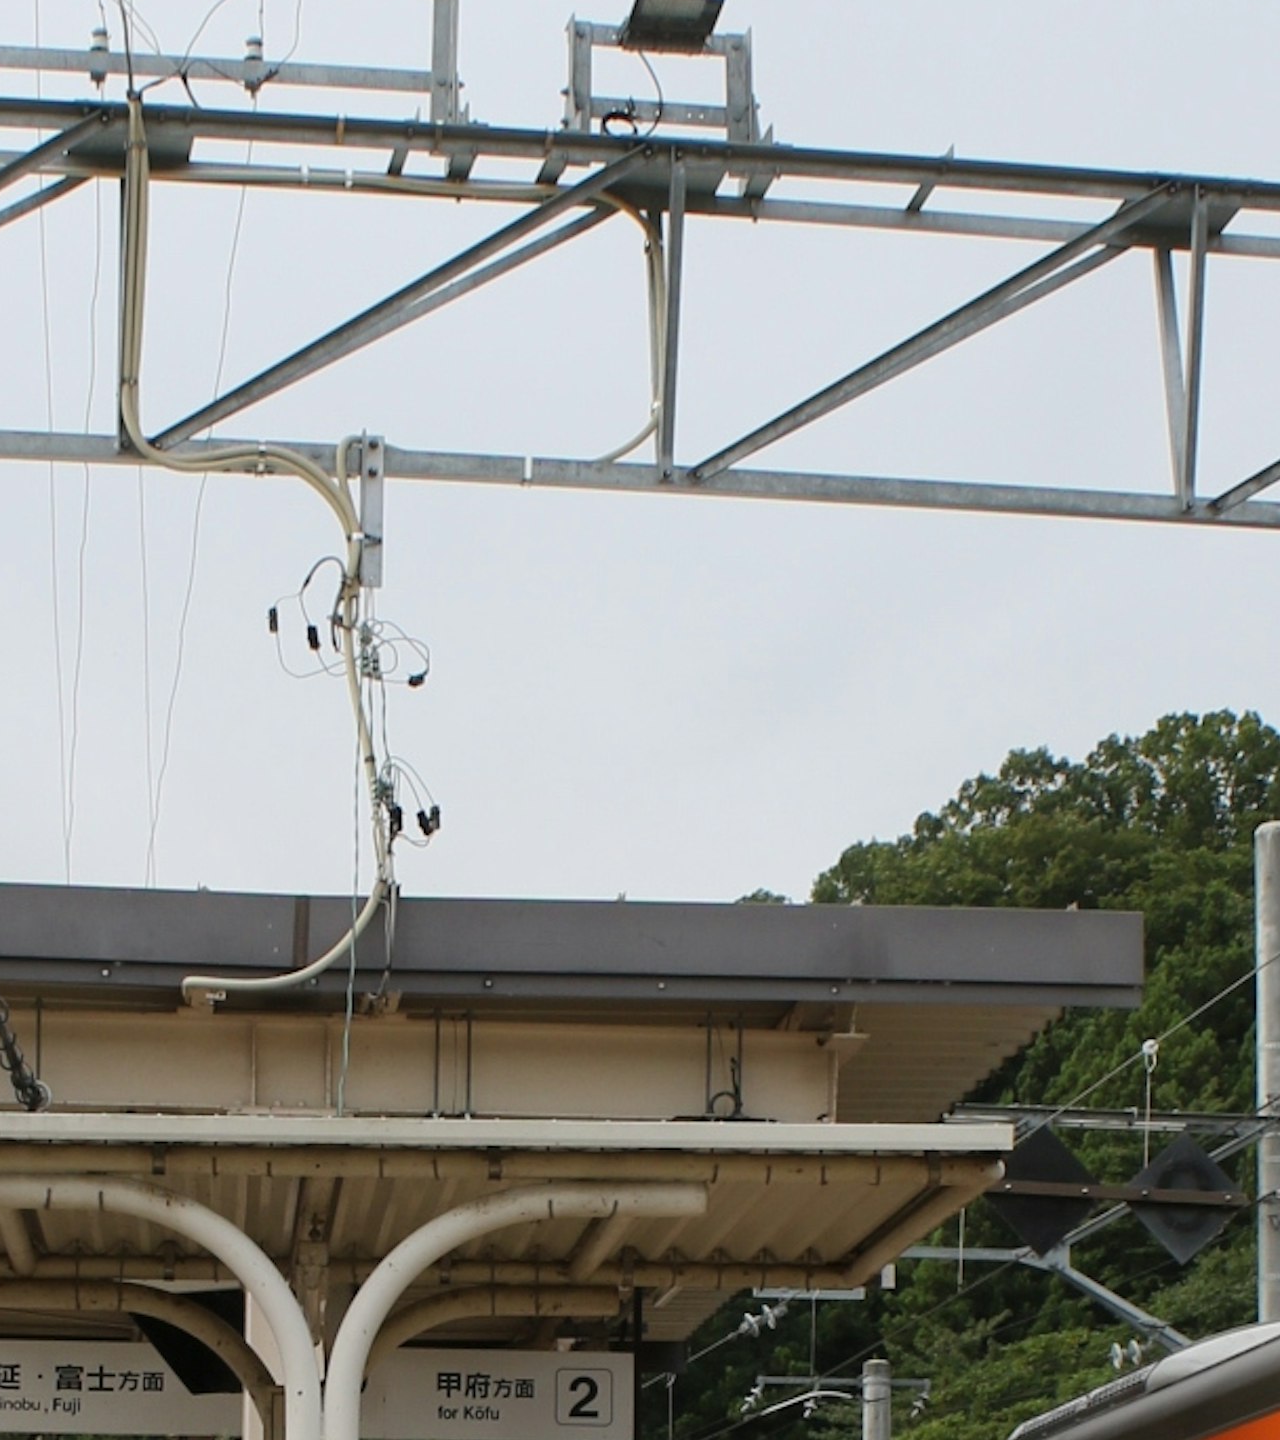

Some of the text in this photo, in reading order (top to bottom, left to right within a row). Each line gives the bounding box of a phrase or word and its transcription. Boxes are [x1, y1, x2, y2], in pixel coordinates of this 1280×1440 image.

[437, 1372, 535, 1399] 甲府方面
[568, 1376, 599, 1418] 2
[52, 1397, 81, 1416] Fuji
[438, 1405, 500, 1420] for Kōfu
